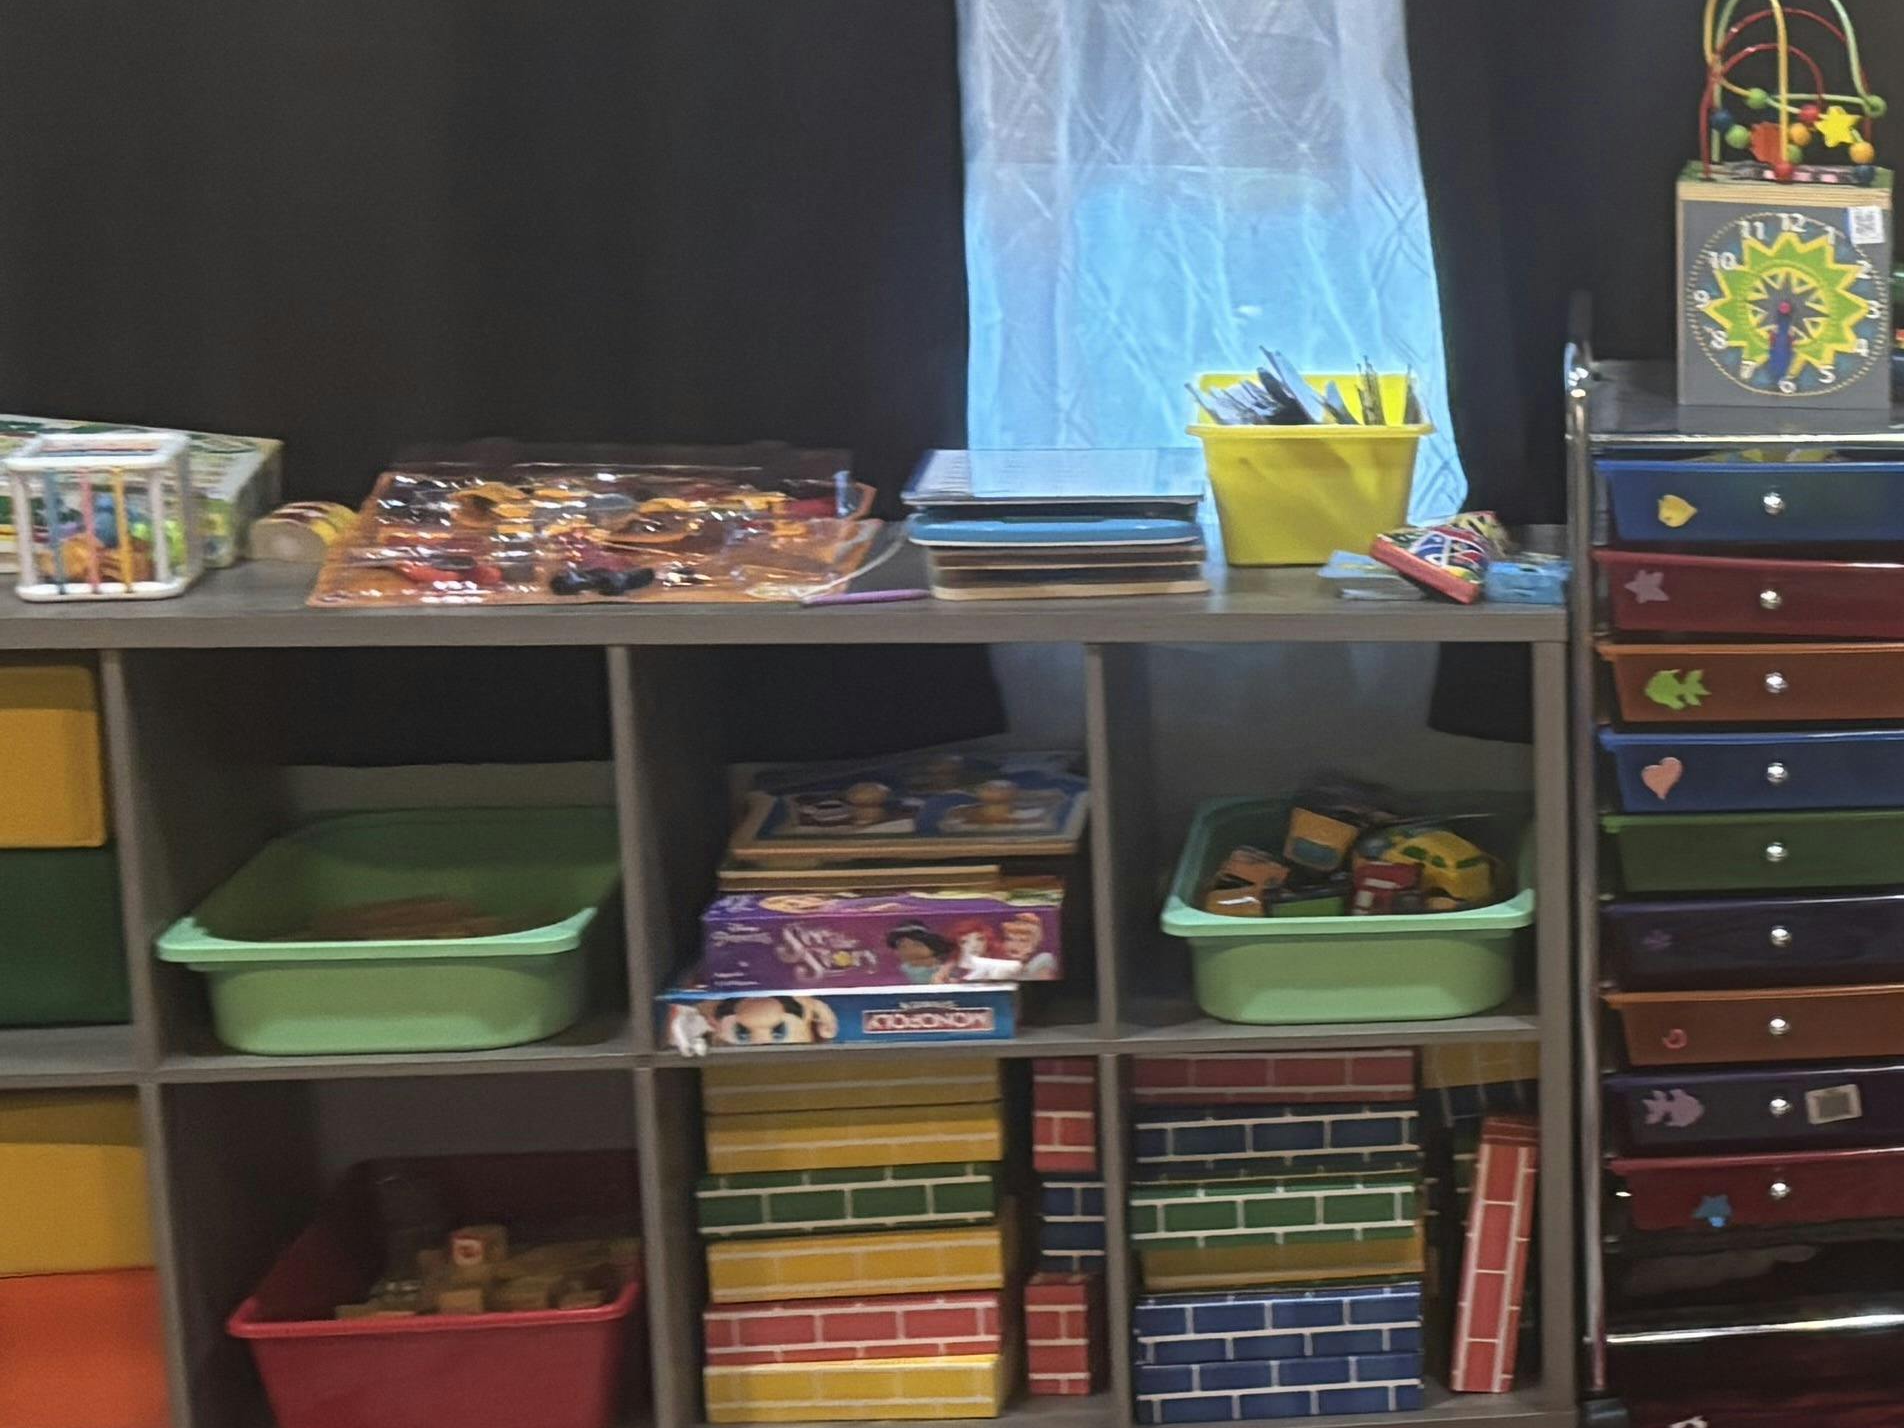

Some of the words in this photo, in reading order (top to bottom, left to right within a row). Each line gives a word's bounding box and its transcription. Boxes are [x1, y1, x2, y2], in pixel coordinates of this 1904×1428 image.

[1736, 221, 1765, 239] 11
[1776, 212, 1808, 232] 12
[1708, 251, 1738, 270] 10
[1855, 260, 1873, 279] 2
[1693, 290, 1710, 308] 9
[1866, 300, 1881, 319] 3
[1817, 364, 1836, 384] 5
[867, 1012, 993, 1030] MONOPOLY
